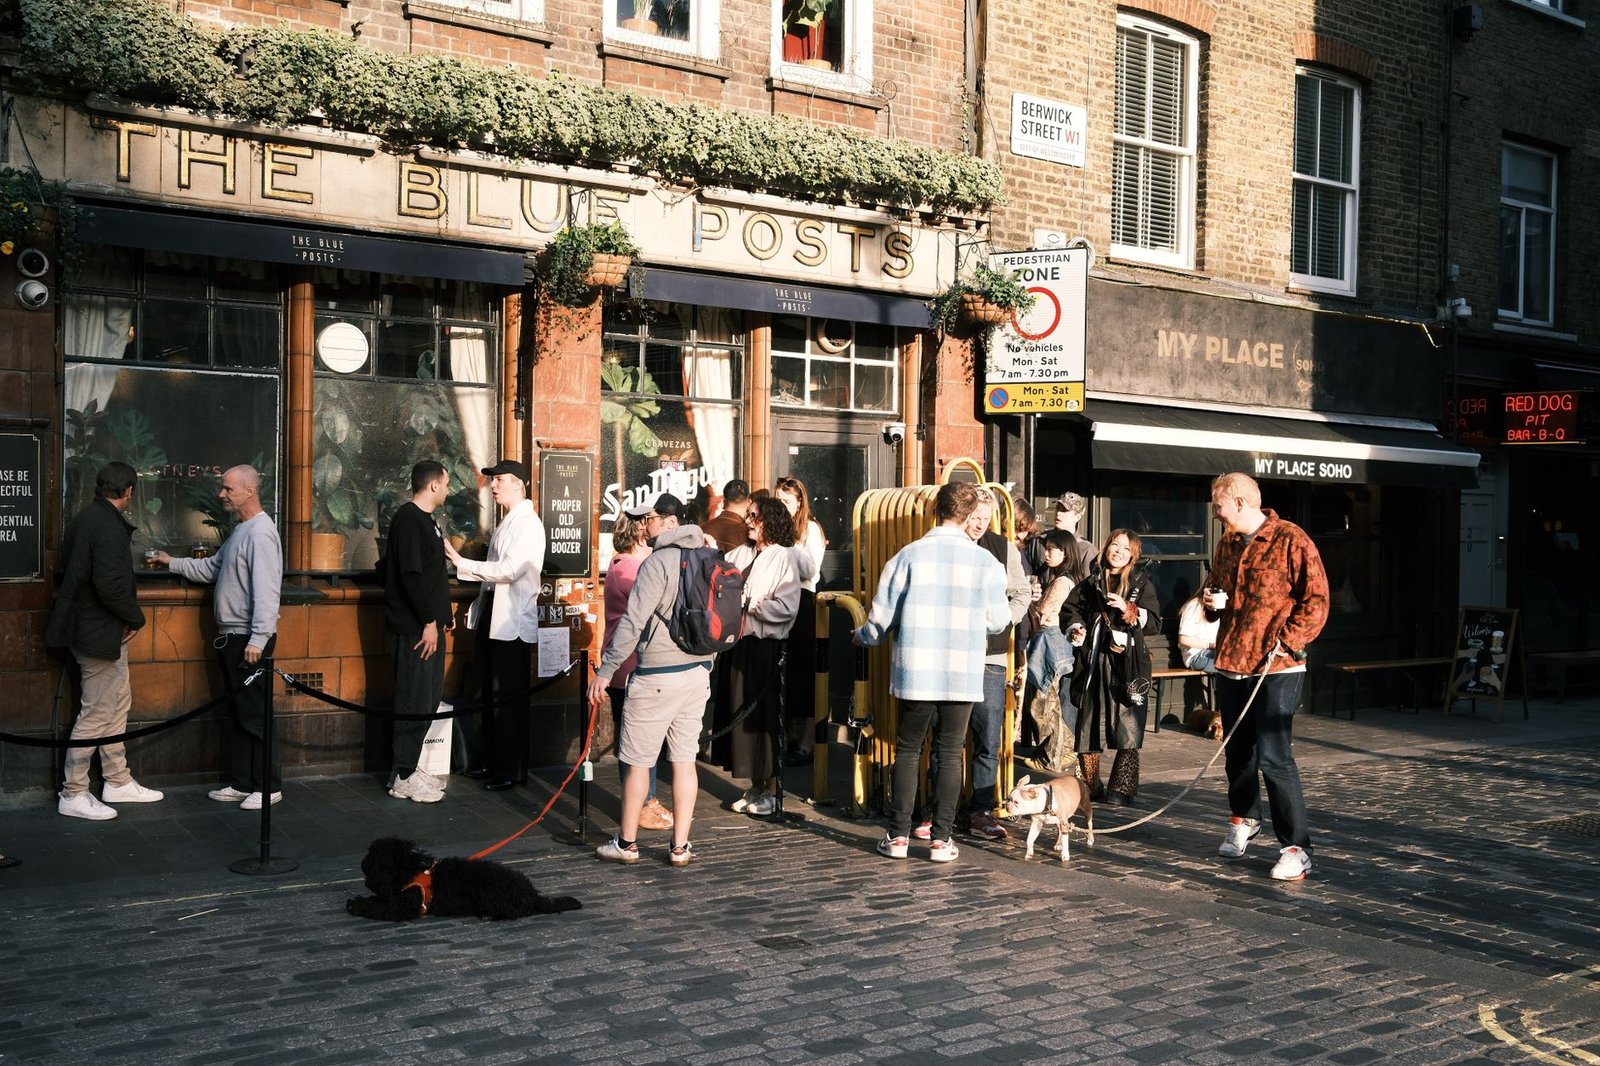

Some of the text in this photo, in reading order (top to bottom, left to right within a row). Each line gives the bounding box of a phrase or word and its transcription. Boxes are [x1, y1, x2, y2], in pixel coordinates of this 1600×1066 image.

[1021, 101, 1072, 126] BERWICK
[1021, 120, 1080, 145] STREET W1
[1020, 143, 1031, 152] CITY
[1032, 145, 1039, 153] OF
[90, 115, 914, 279] THE BLUE POSTS
[292, 236, 344, 250] THE BLUE
[302, 251, 334, 263] POSTS
[1003, 254, 1071, 266] PEDESTRIAN
[1013, 267, 1060, 282] ZONE
[775, 289, 812, 301] THE BLUE
[782, 302, 806, 312] POSTS
[1007, 343, 1064, 353] No vehicles
[1158, 329, 1284, 369] MY PLACE
[1012, 357, 1033, 366] Mon
[1040, 356, 1058, 365] Sat
[1023, 386, 1044, 395] Mon
[1051, 385, 1069, 394] Sat
[1505, 394, 1572, 412] RED DOG
[1525, 414, 1550, 426] PIT
[645, 439, 692, 449] CERVEZAS
[1255, 458, 1352, 479] MY PLACE SOHO
[17, 470, 29, 481] BE
[563, 485, 570, 498] A
[551, 500, 582, 512] PROPER
[599, 483, 652, 521] San
[558, 514, 574, 526] OLD
[550, 528, 582, 540] LONDON
[551, 542, 581, 554] BOOZER
